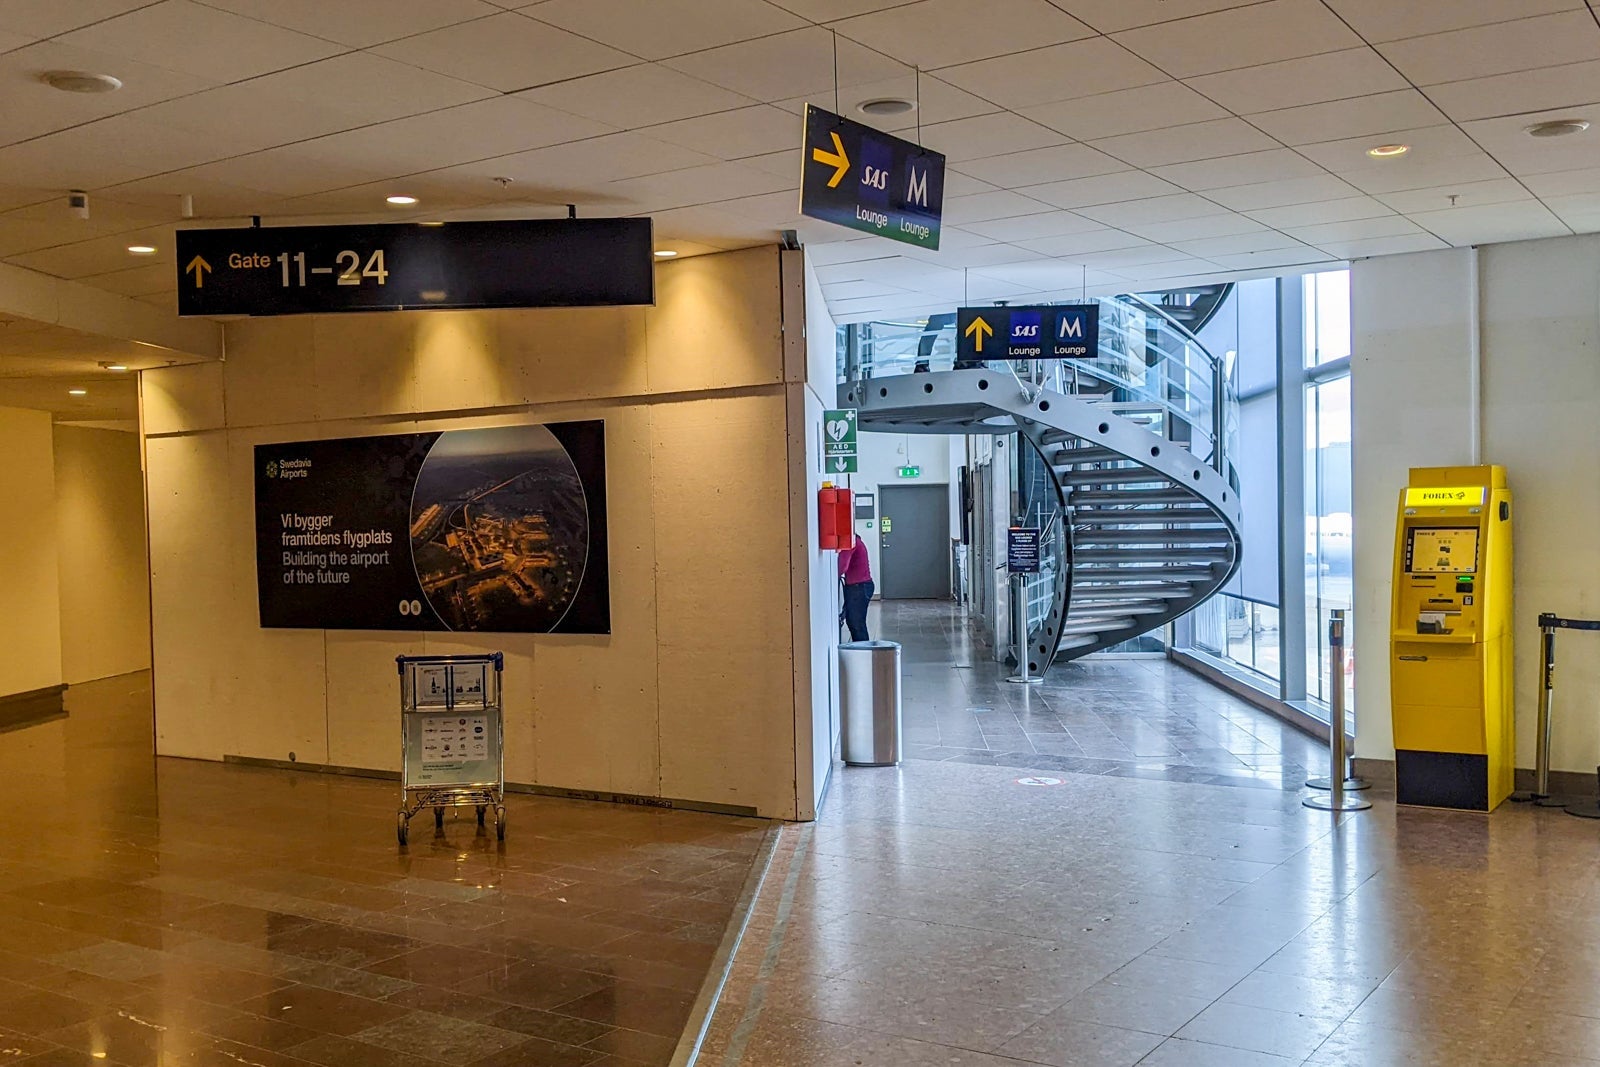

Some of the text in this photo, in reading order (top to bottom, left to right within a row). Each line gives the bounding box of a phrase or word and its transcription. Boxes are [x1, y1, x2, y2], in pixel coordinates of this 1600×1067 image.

[861, 165, 928, 208] SAS M
[856, 204, 930, 240] Lounge Lounge
[228, 252, 271, 269] Gate
[1011, 316, 1082, 338] SAS M
[1008, 345, 1086, 356] Lounge Lounge
[279, 457, 312, 469] Swedavia
[279, 469, 308, 480] Airports
[281, 513, 334, 531] Vi bygger
[281, 529, 393, 548] framtidens flygplats
[282, 550, 390, 569] Building the airport
[283, 569, 350, 584] of the future
